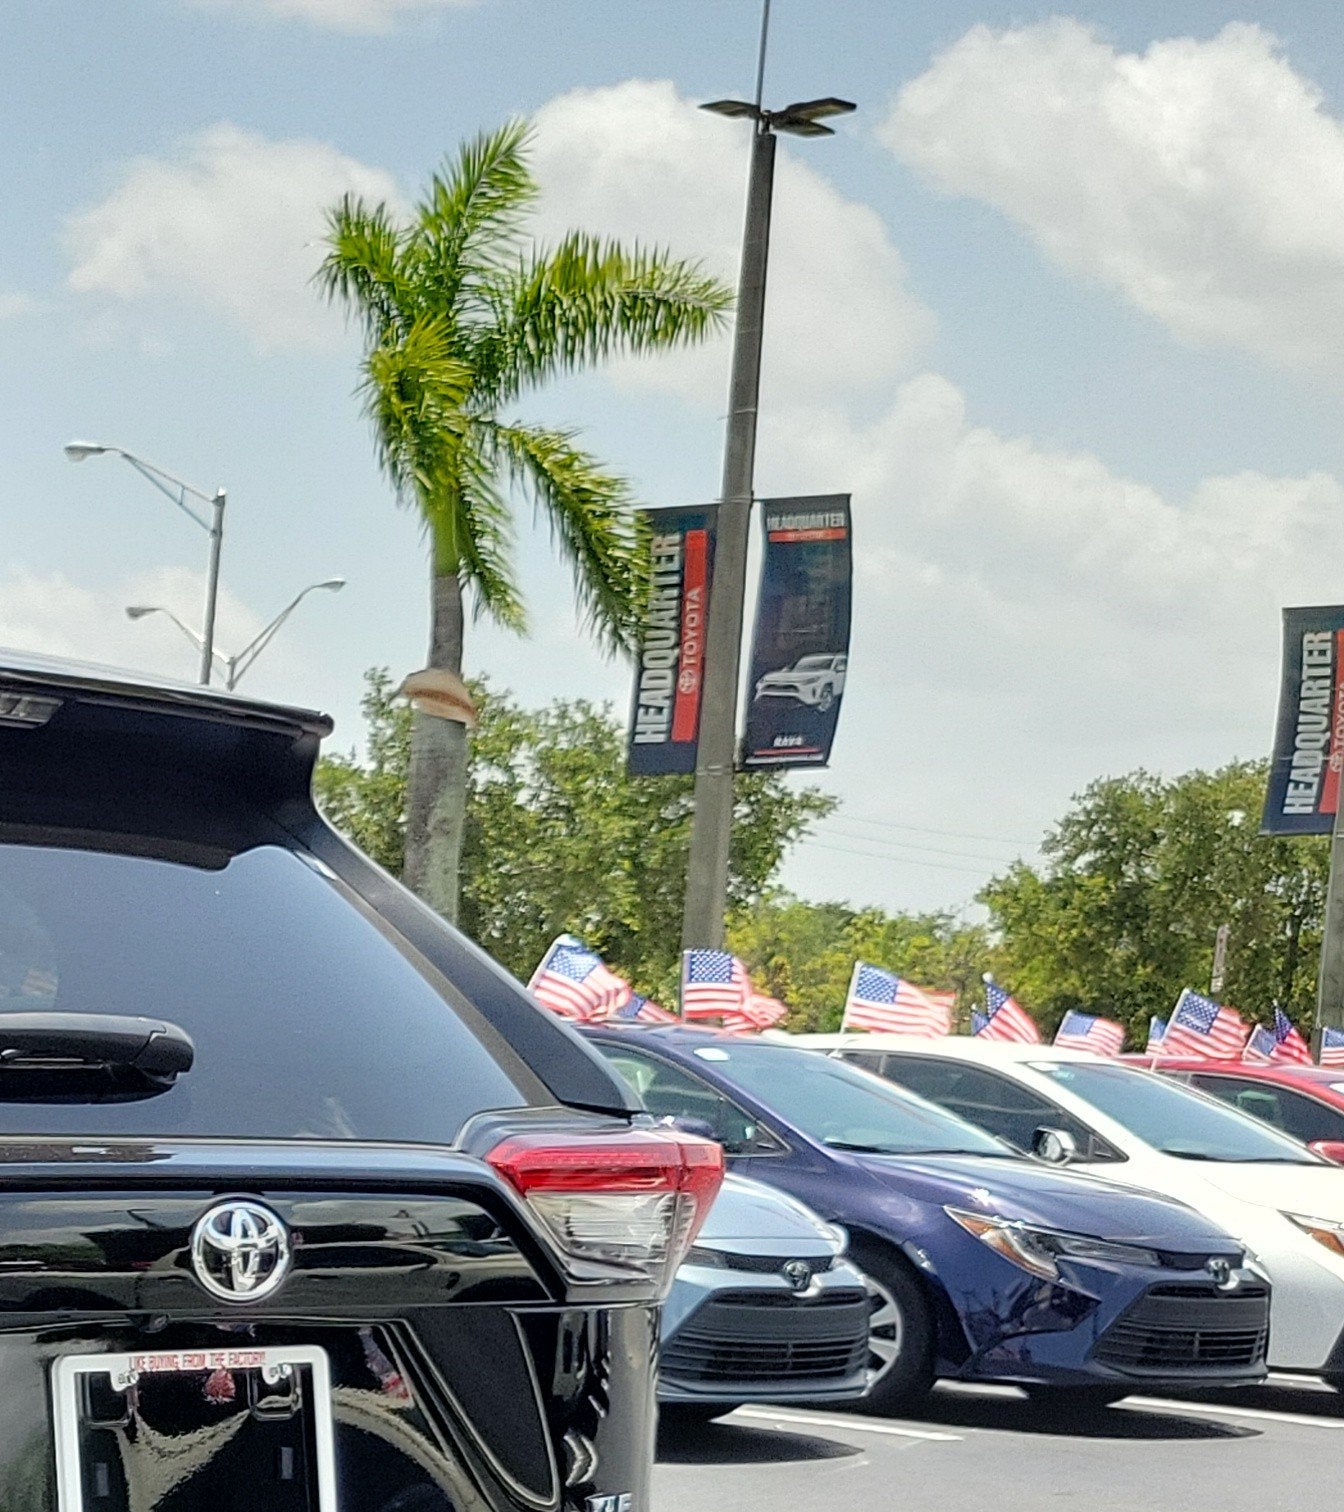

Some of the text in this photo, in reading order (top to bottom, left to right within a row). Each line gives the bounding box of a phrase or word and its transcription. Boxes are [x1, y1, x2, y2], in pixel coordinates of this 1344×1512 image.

[633, 531, 682, 745] HEADQUARTER
[683, 588, 701, 667] TOYOTA
[1282, 630, 1333, 814] HEADQUARTER
